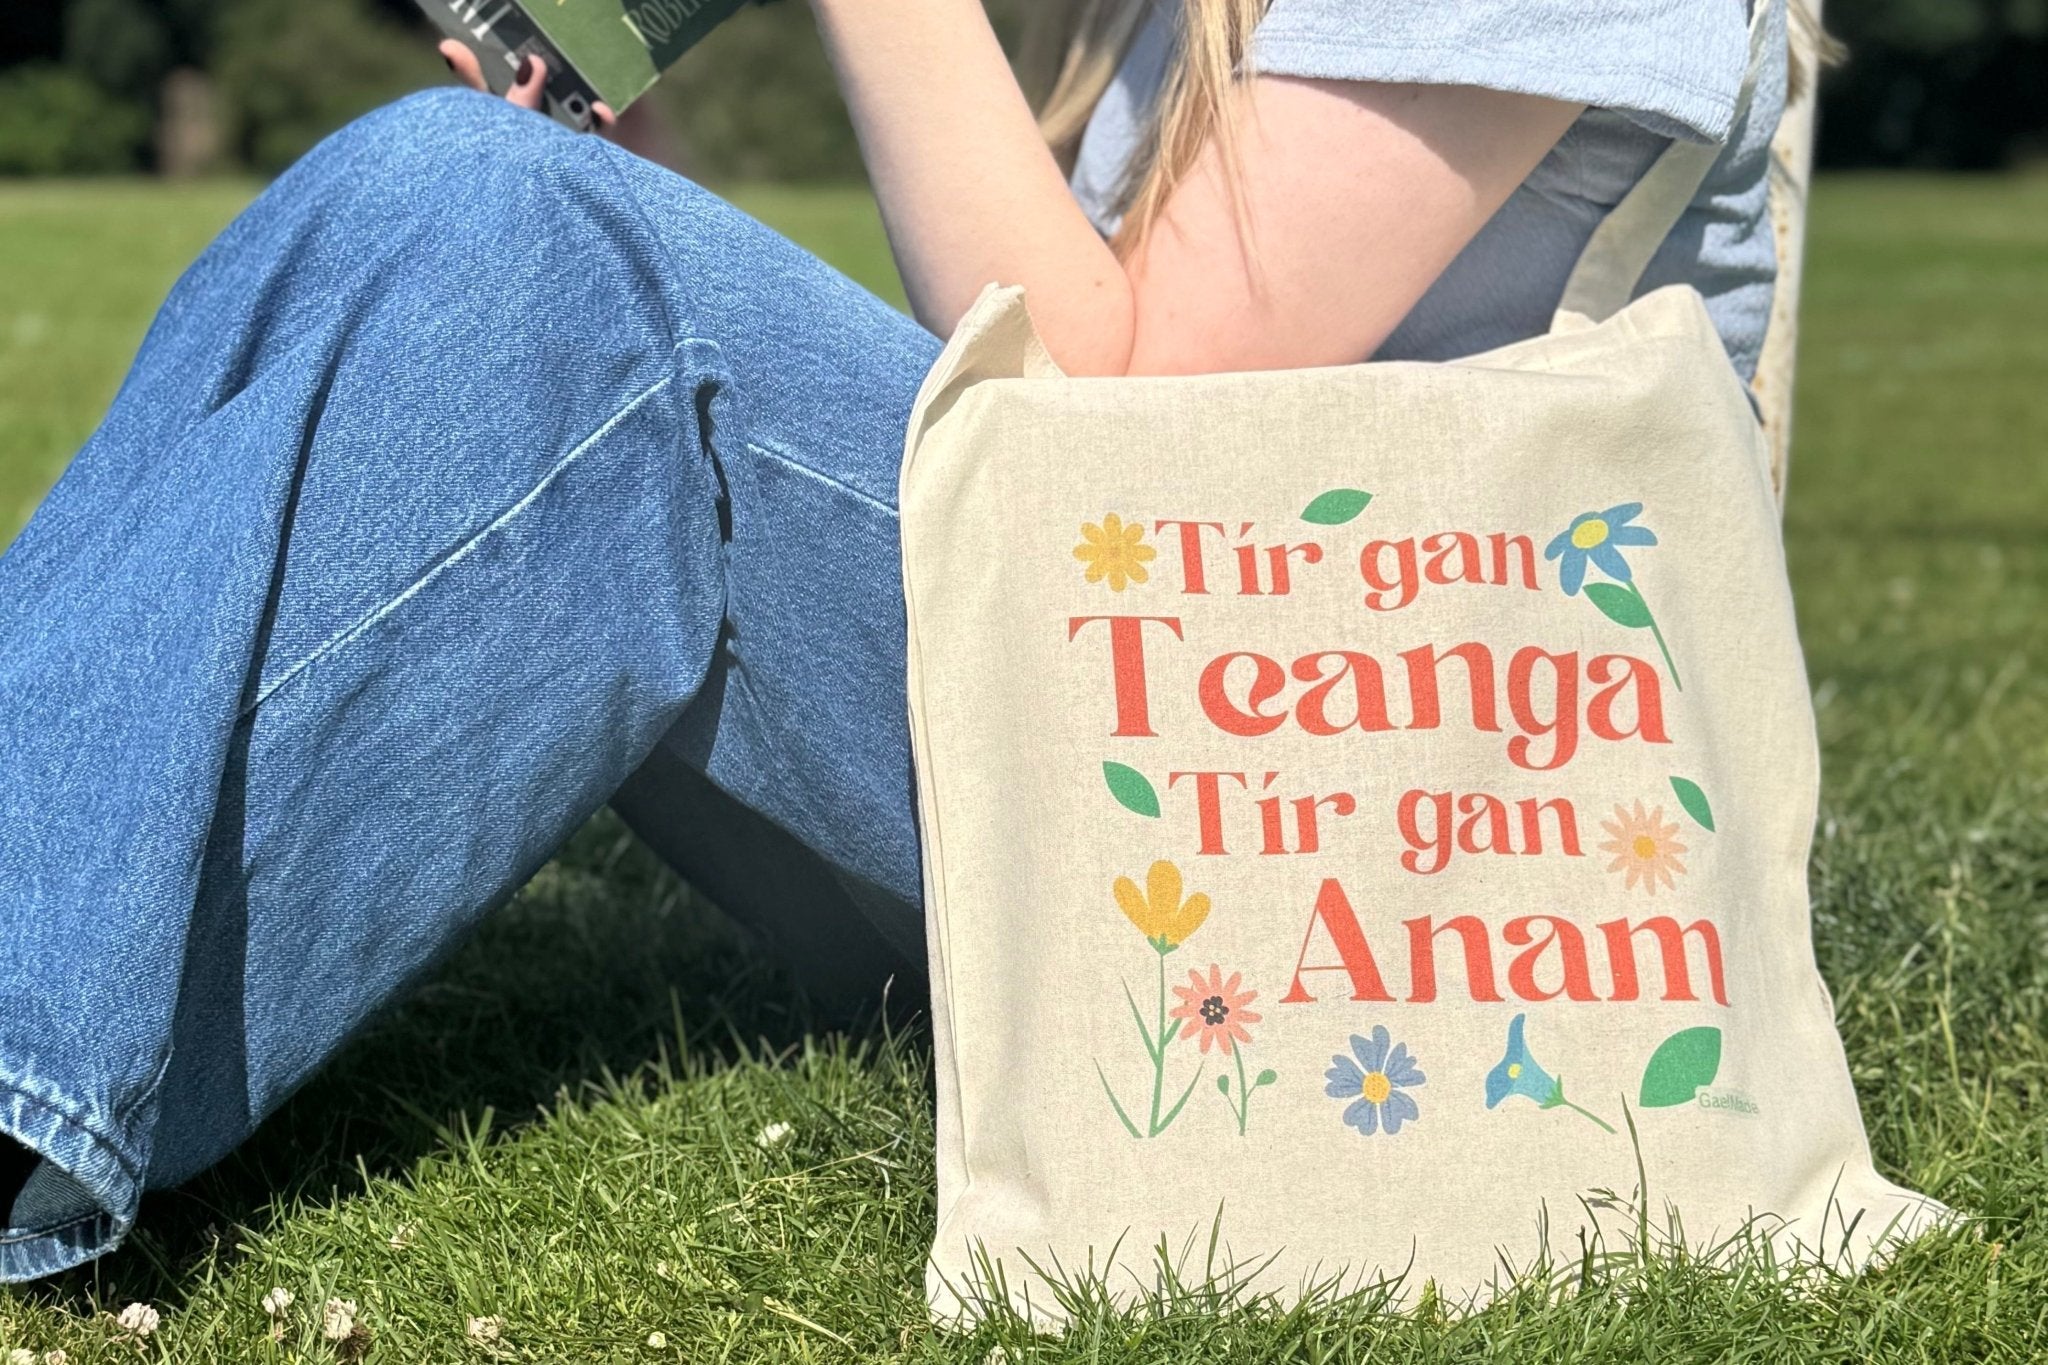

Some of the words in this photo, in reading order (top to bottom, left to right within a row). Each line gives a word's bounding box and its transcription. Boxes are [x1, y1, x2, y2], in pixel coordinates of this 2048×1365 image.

[1155, 520, 1323, 595] Tír
[1360, 532, 1542, 611] gan
[1068, 615, 1672, 770] Teanga
[1168, 771, 1356, 856] Tír
[1397, 788, 1585, 874] gan
[1279, 877, 1730, 1006] Anam
